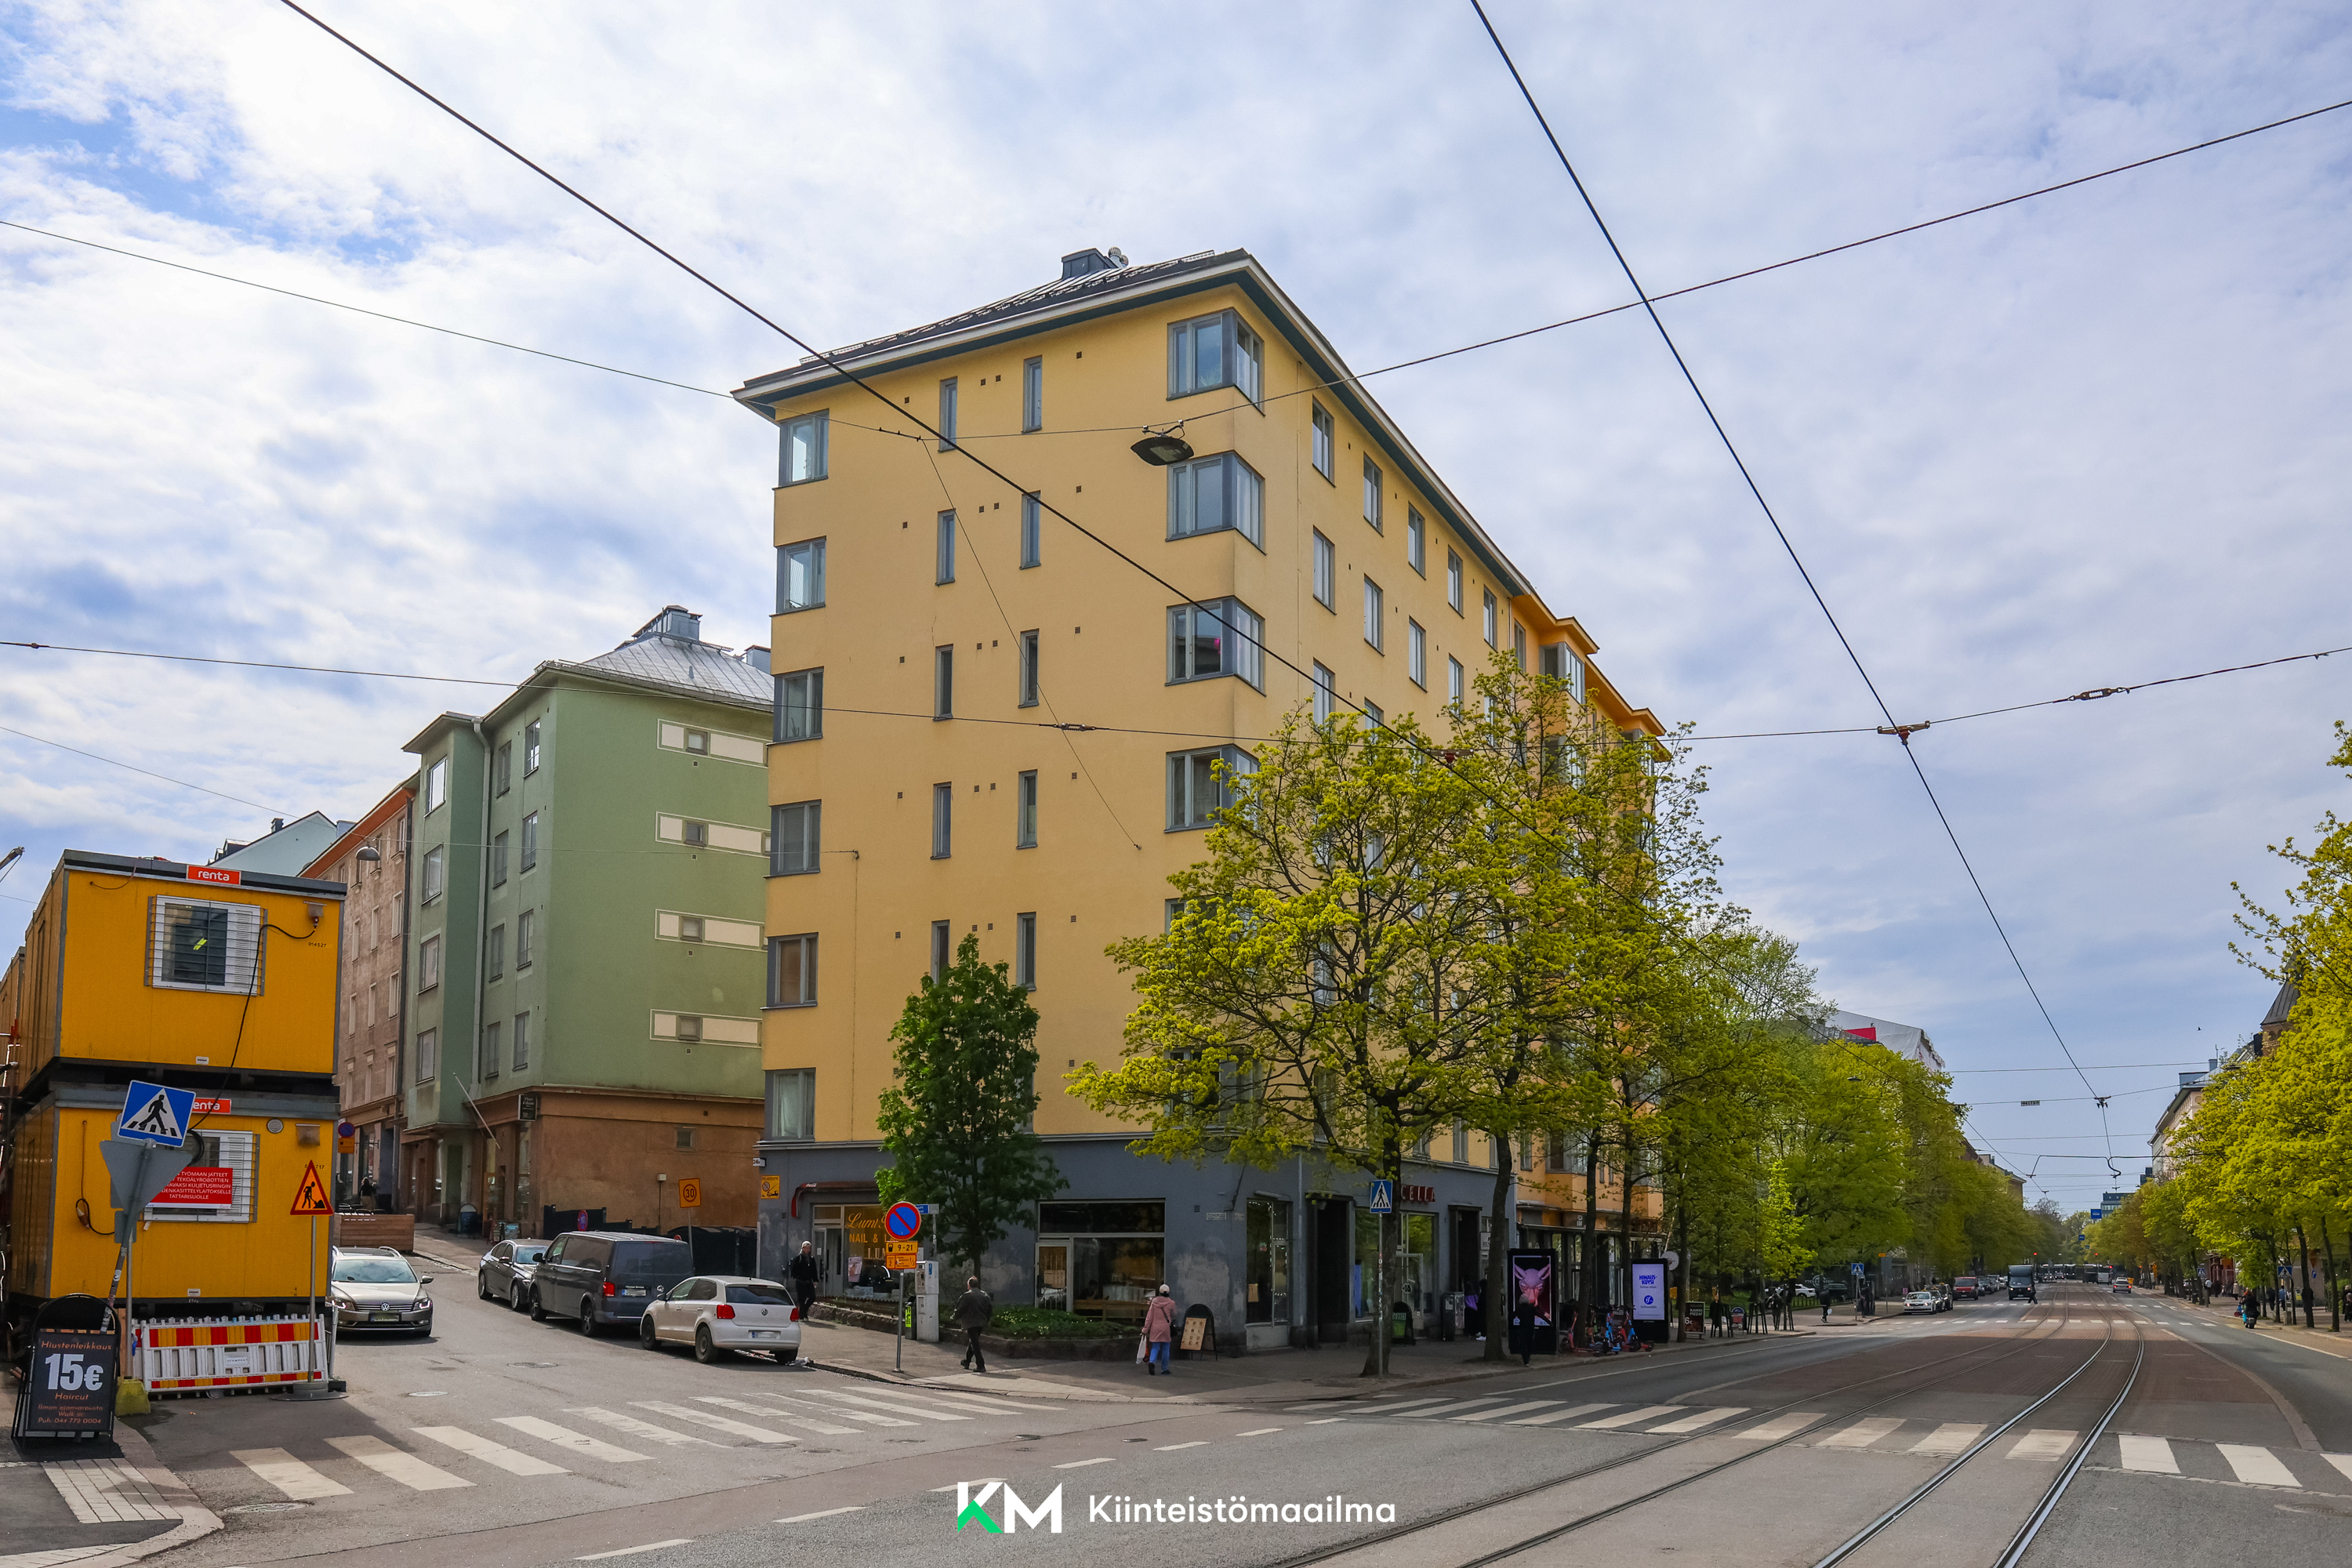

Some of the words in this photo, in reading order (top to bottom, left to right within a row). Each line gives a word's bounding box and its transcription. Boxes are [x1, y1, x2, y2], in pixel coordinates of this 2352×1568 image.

[198, 870, 230, 881] renta
[192, 1102, 220, 1110] enta
[685, 1188, 695, 1199] 30
[1400, 1184, 1436, 1203] CELLA
[849, 1233, 868, 1243] NAIL
[873, 1233, 878, 1243] &
[41, 1341, 112, 1350] Hiustenleikkaus
[45, 1353, 104, 1391] 15€
